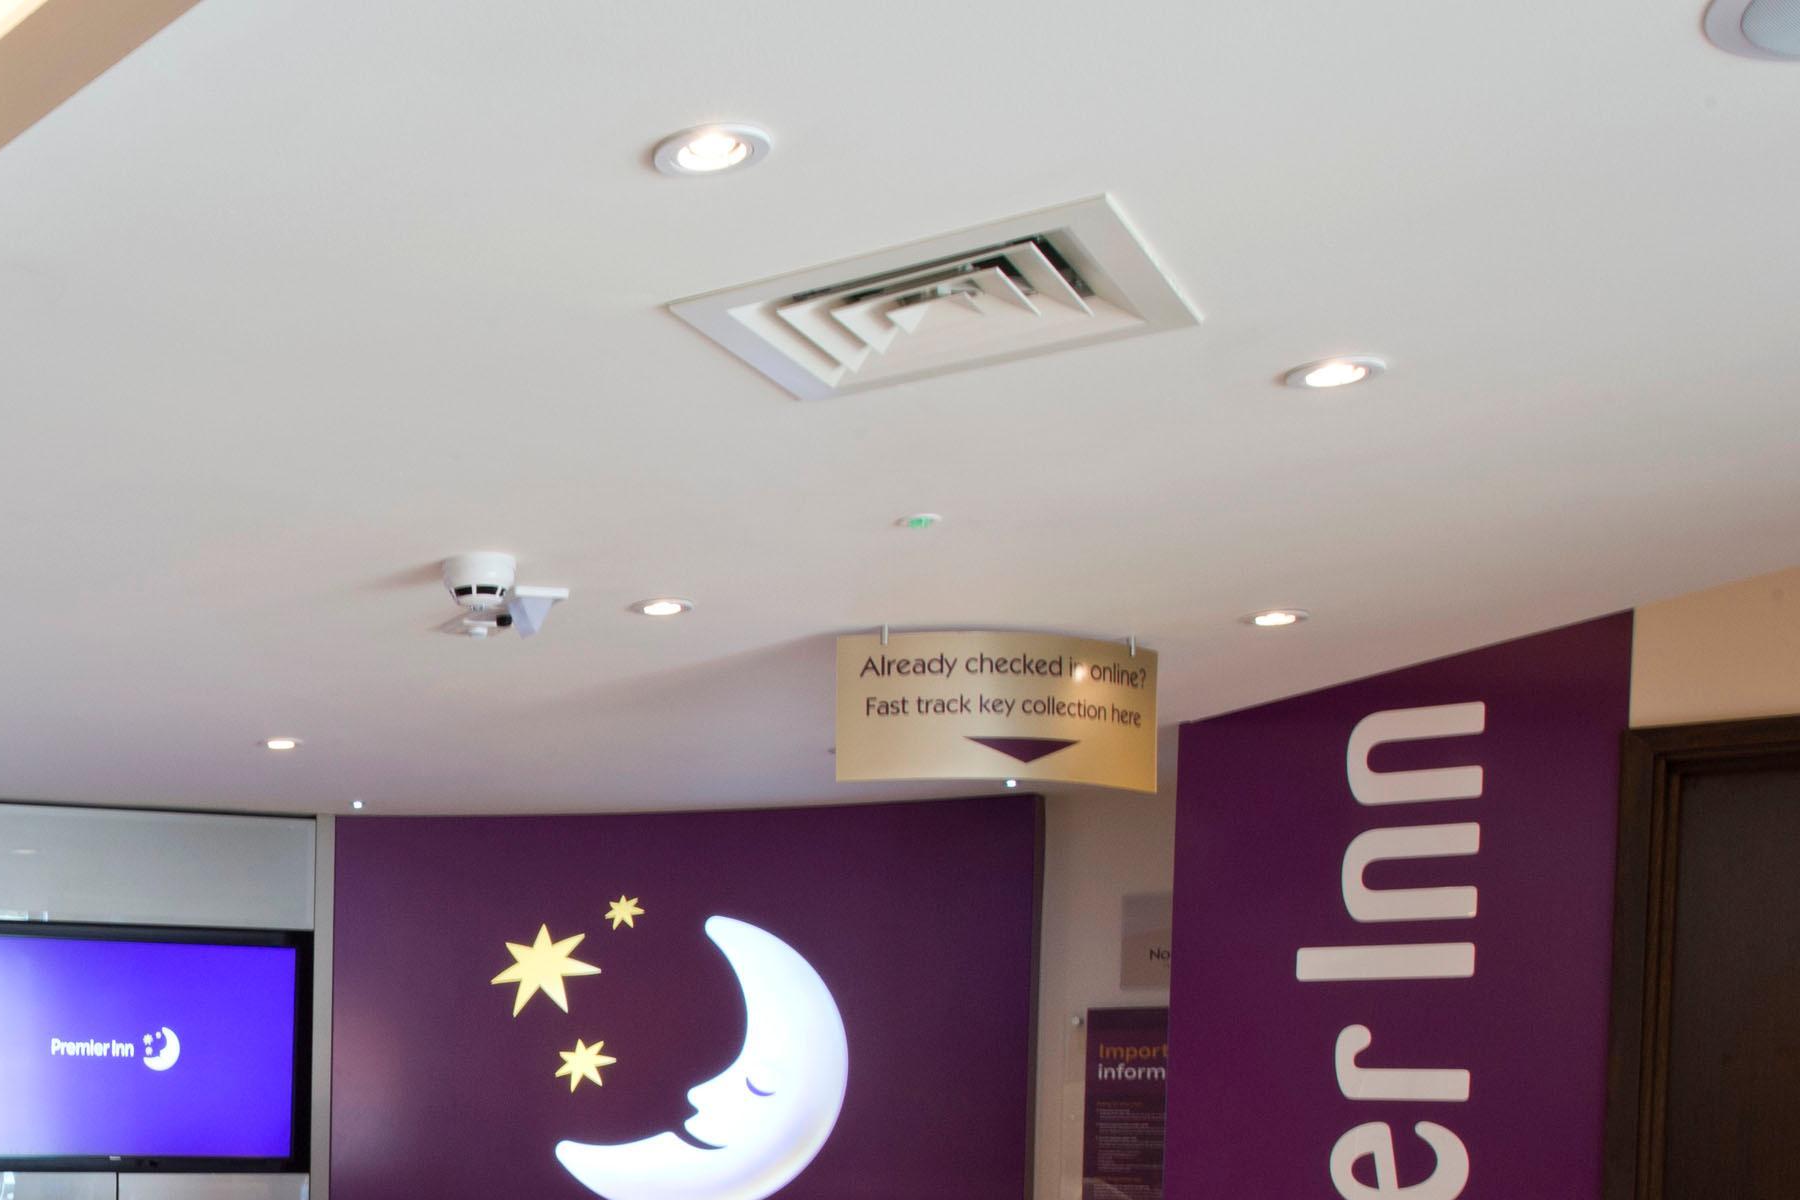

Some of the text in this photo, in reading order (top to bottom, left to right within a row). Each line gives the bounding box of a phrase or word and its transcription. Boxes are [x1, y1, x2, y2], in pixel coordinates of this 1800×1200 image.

[860, 653, 957, 679] Already
[965, 653, 1063, 678] checked
[1090, 662, 1147, 690] online?
[865, 694, 1142, 727] Fast track key collection here
[1295, 700, 1486, 982] Inn
[51, 1038, 135, 1058] Premier Inn
